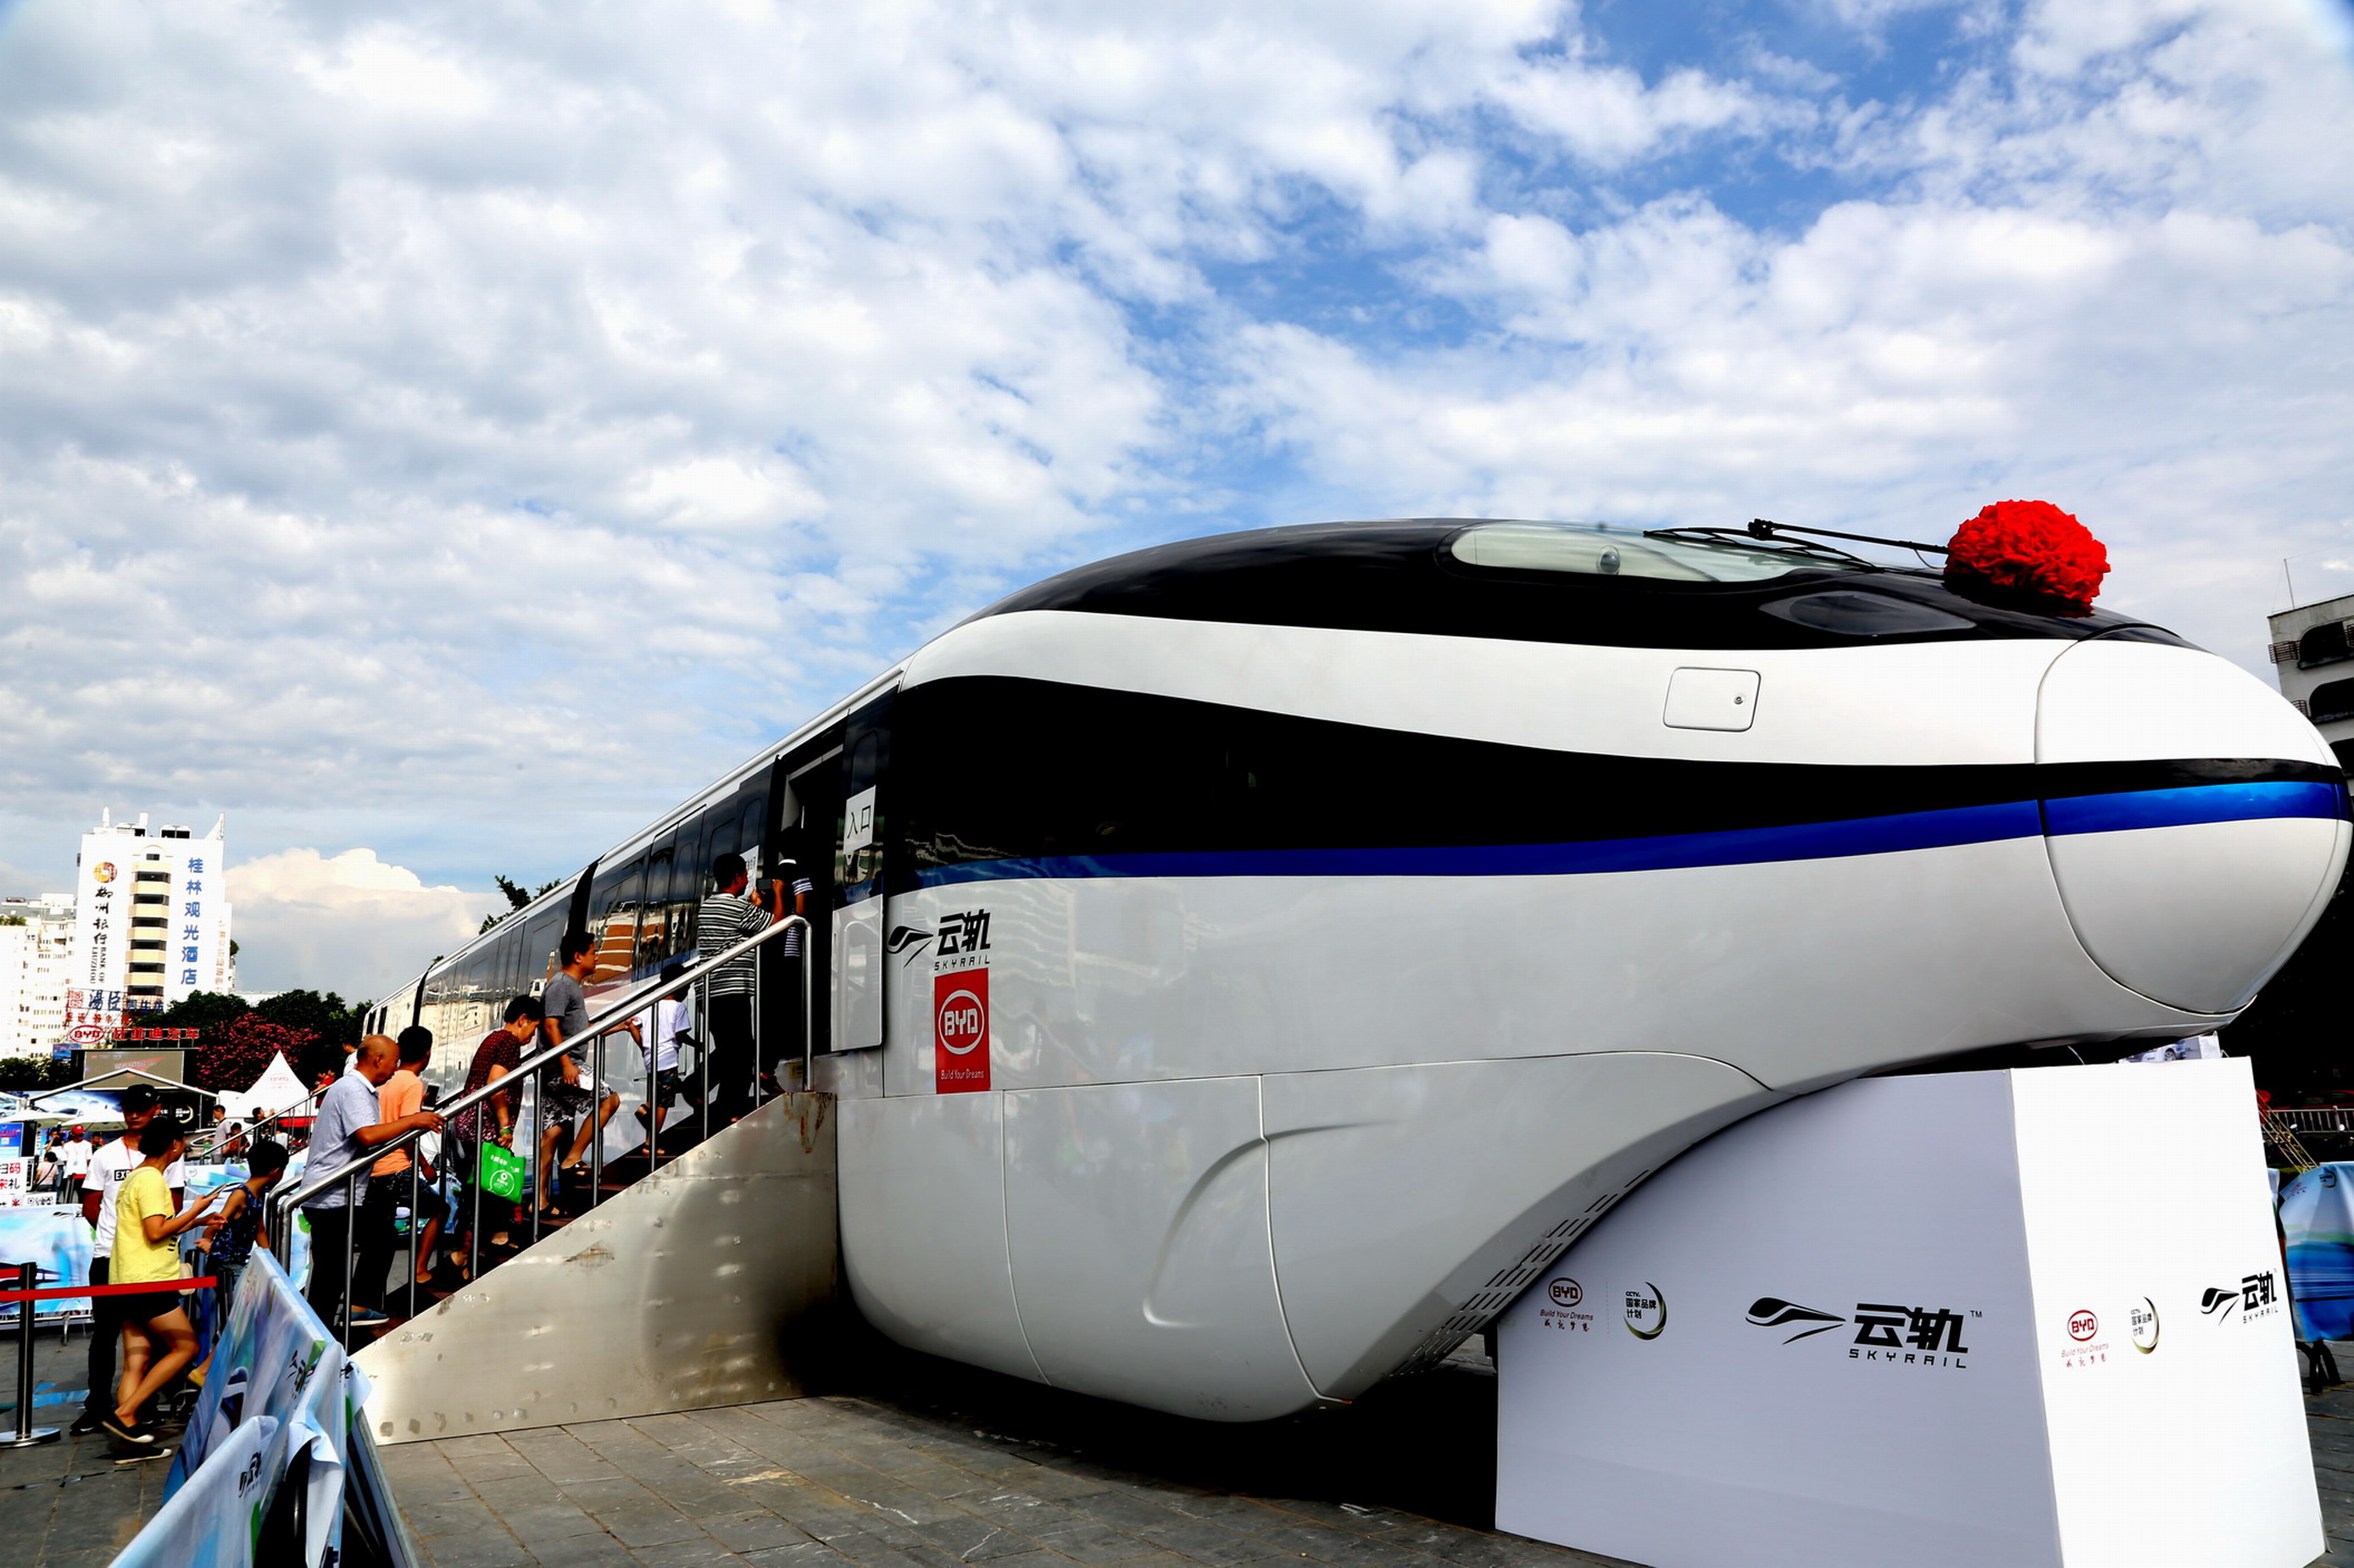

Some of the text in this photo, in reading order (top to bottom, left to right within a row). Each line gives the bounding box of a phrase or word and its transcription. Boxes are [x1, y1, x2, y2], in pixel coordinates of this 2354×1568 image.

[847, 804, 871, 839] 入口
[92, 886, 114, 945] 柳州银行
[181, 858, 203, 985] 桂林观光酒店
[937, 909, 991, 956] 云轨
[934, 955, 990, 971] SKYRAIL
[944, 1008, 978, 1037] BYD
[940, 1068, 984, 1081] Build Your Dreams
[1553, 1286, 1578, 1299] BYD
[2241, 1271, 2277, 1311] 云轨
[1626, 1298, 1656, 1309] 国家品牌
[1539, 1309, 1594, 1321] Build Your Dreams
[1627, 1309, 1642, 1320] 计划
[1854, 1303, 1967, 1354] 云轨
[2071, 1318, 2095, 1333] BYD
[1849, 1348, 1967, 1369] SKYRAIL
[2061, 1349, 2075, 1358] Build
[2089, 1343, 2109, 1353] Dreams
